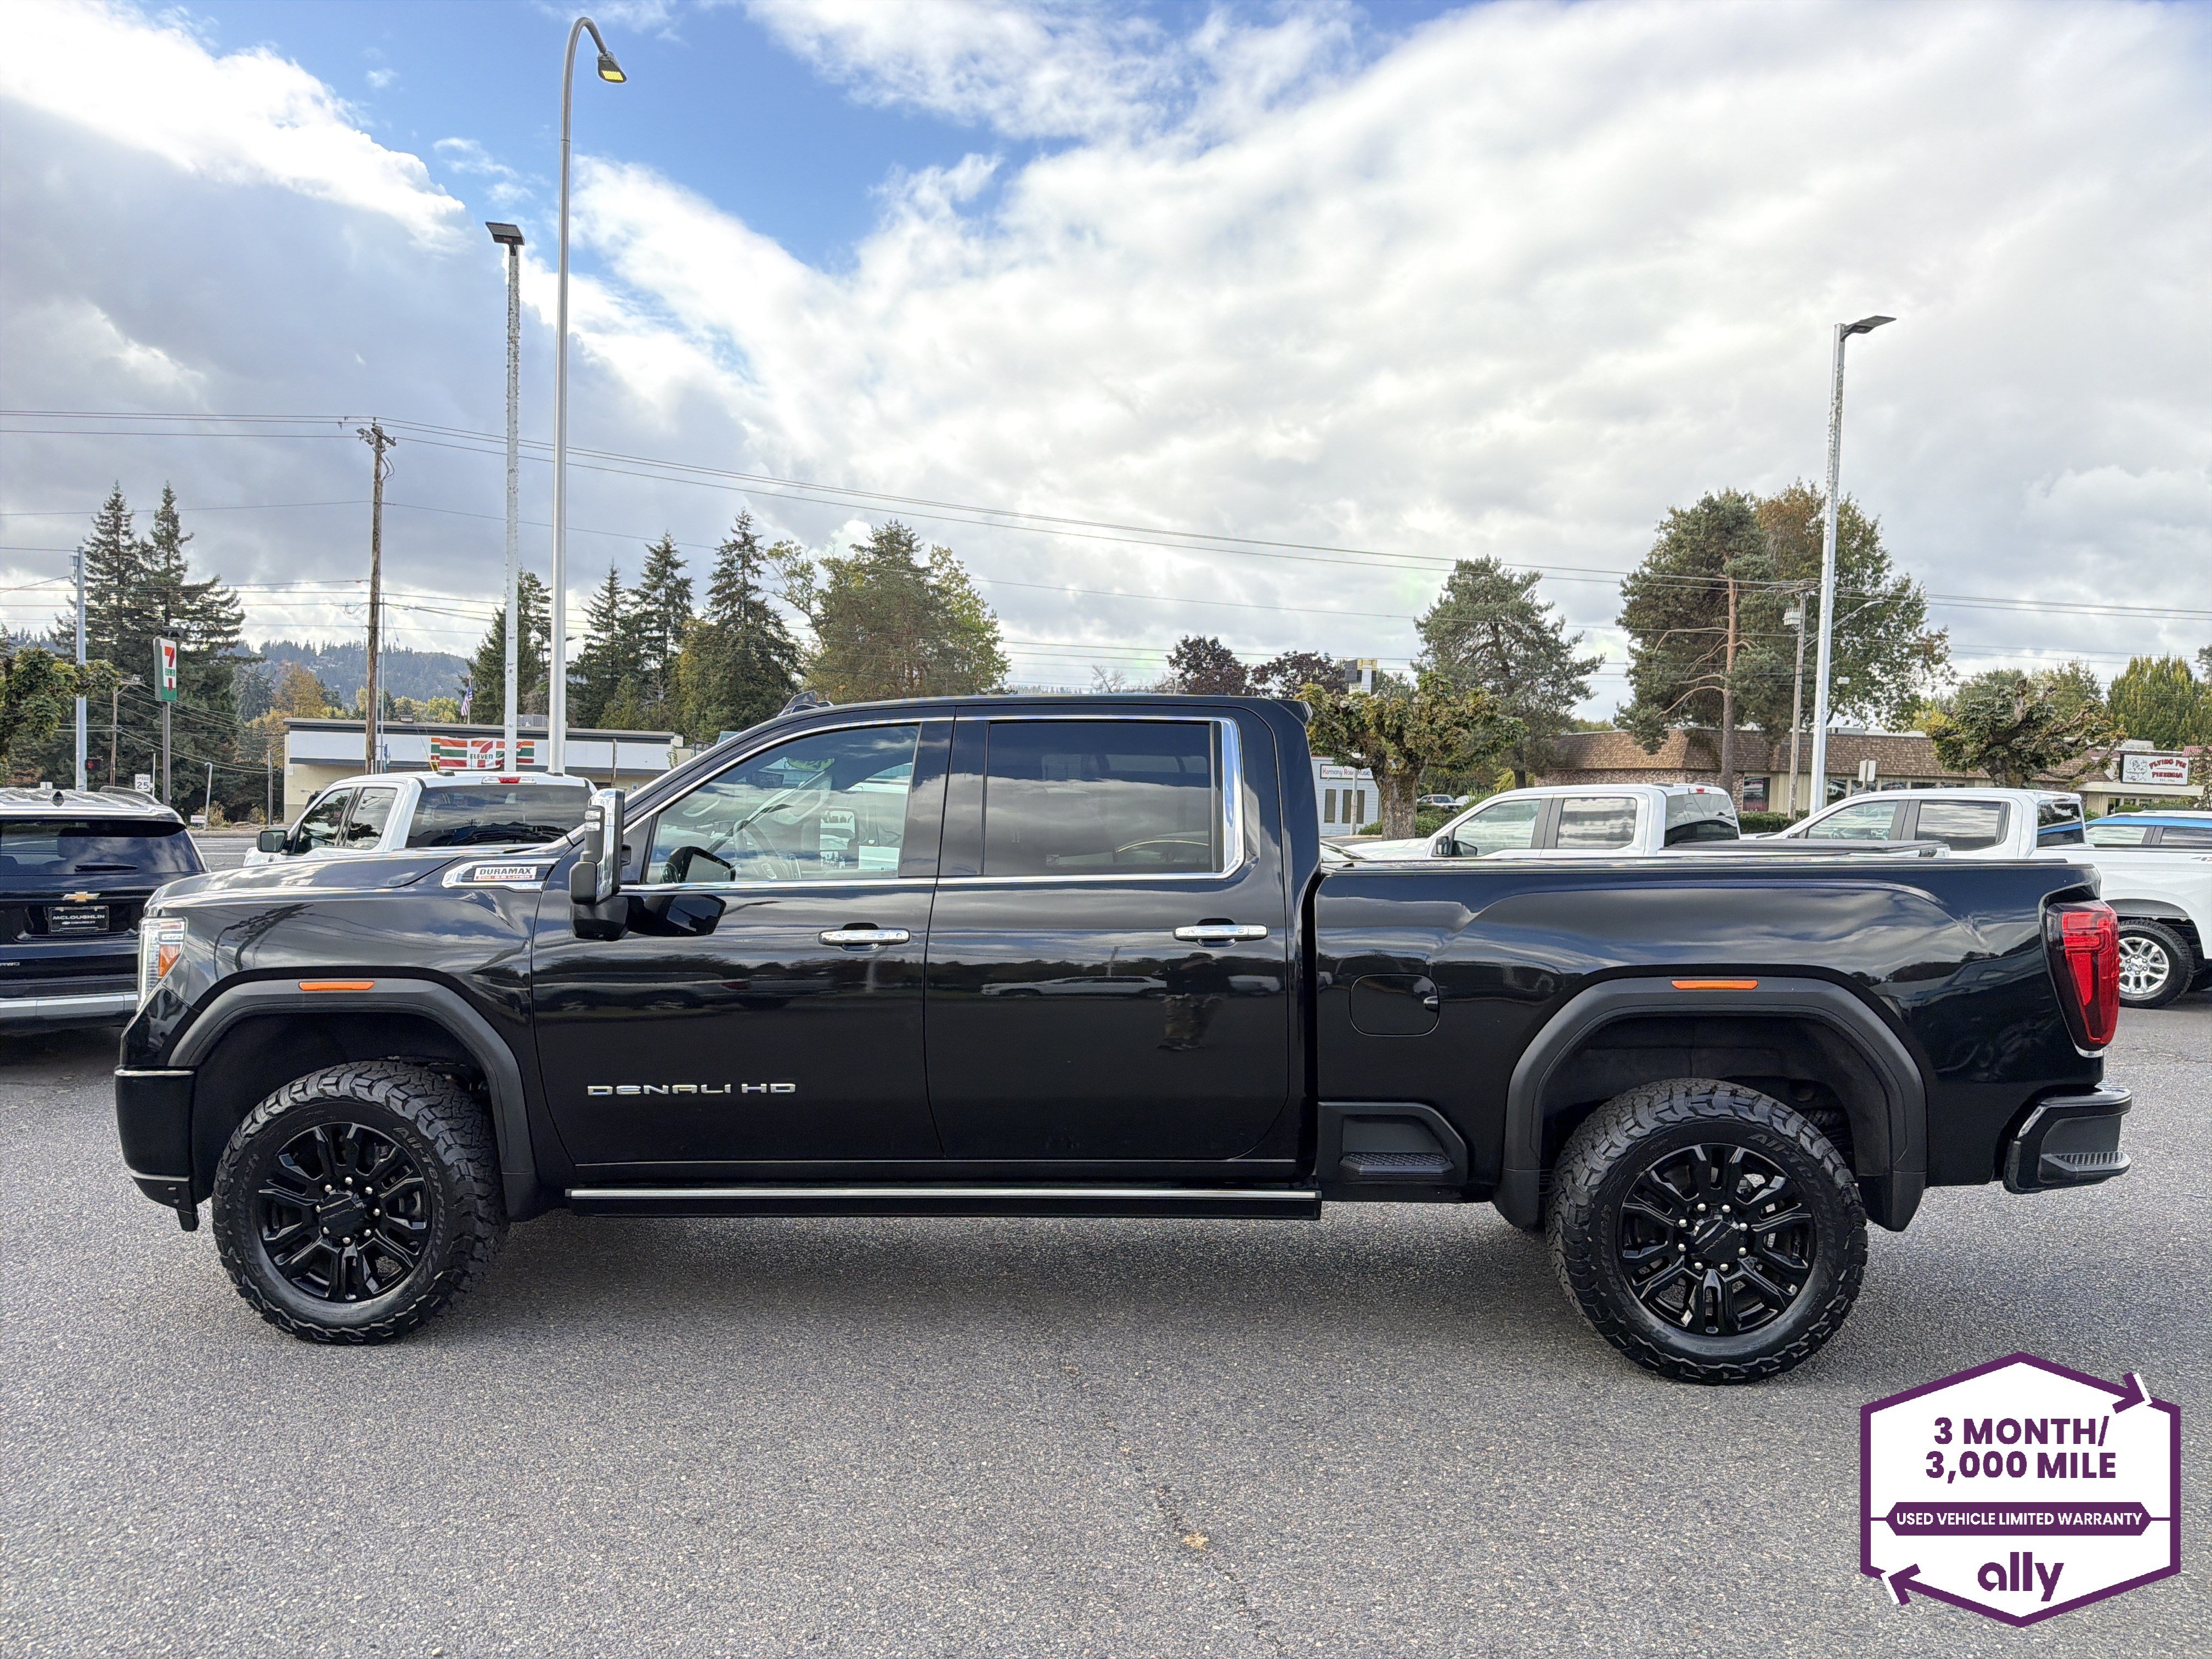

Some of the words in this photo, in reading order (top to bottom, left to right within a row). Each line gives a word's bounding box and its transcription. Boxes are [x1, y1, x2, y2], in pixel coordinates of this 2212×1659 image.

[471, 741, 493, 768] 7
[2149, 759, 2174, 770] FLYING
[2175, 760, 2187, 769] PIE
[1323, 768, 1342, 777] Harmony
[137, 781, 149, 789] 25
[587, 1084, 731, 1096] DENALI
[741, 1083, 796, 1094] HD
